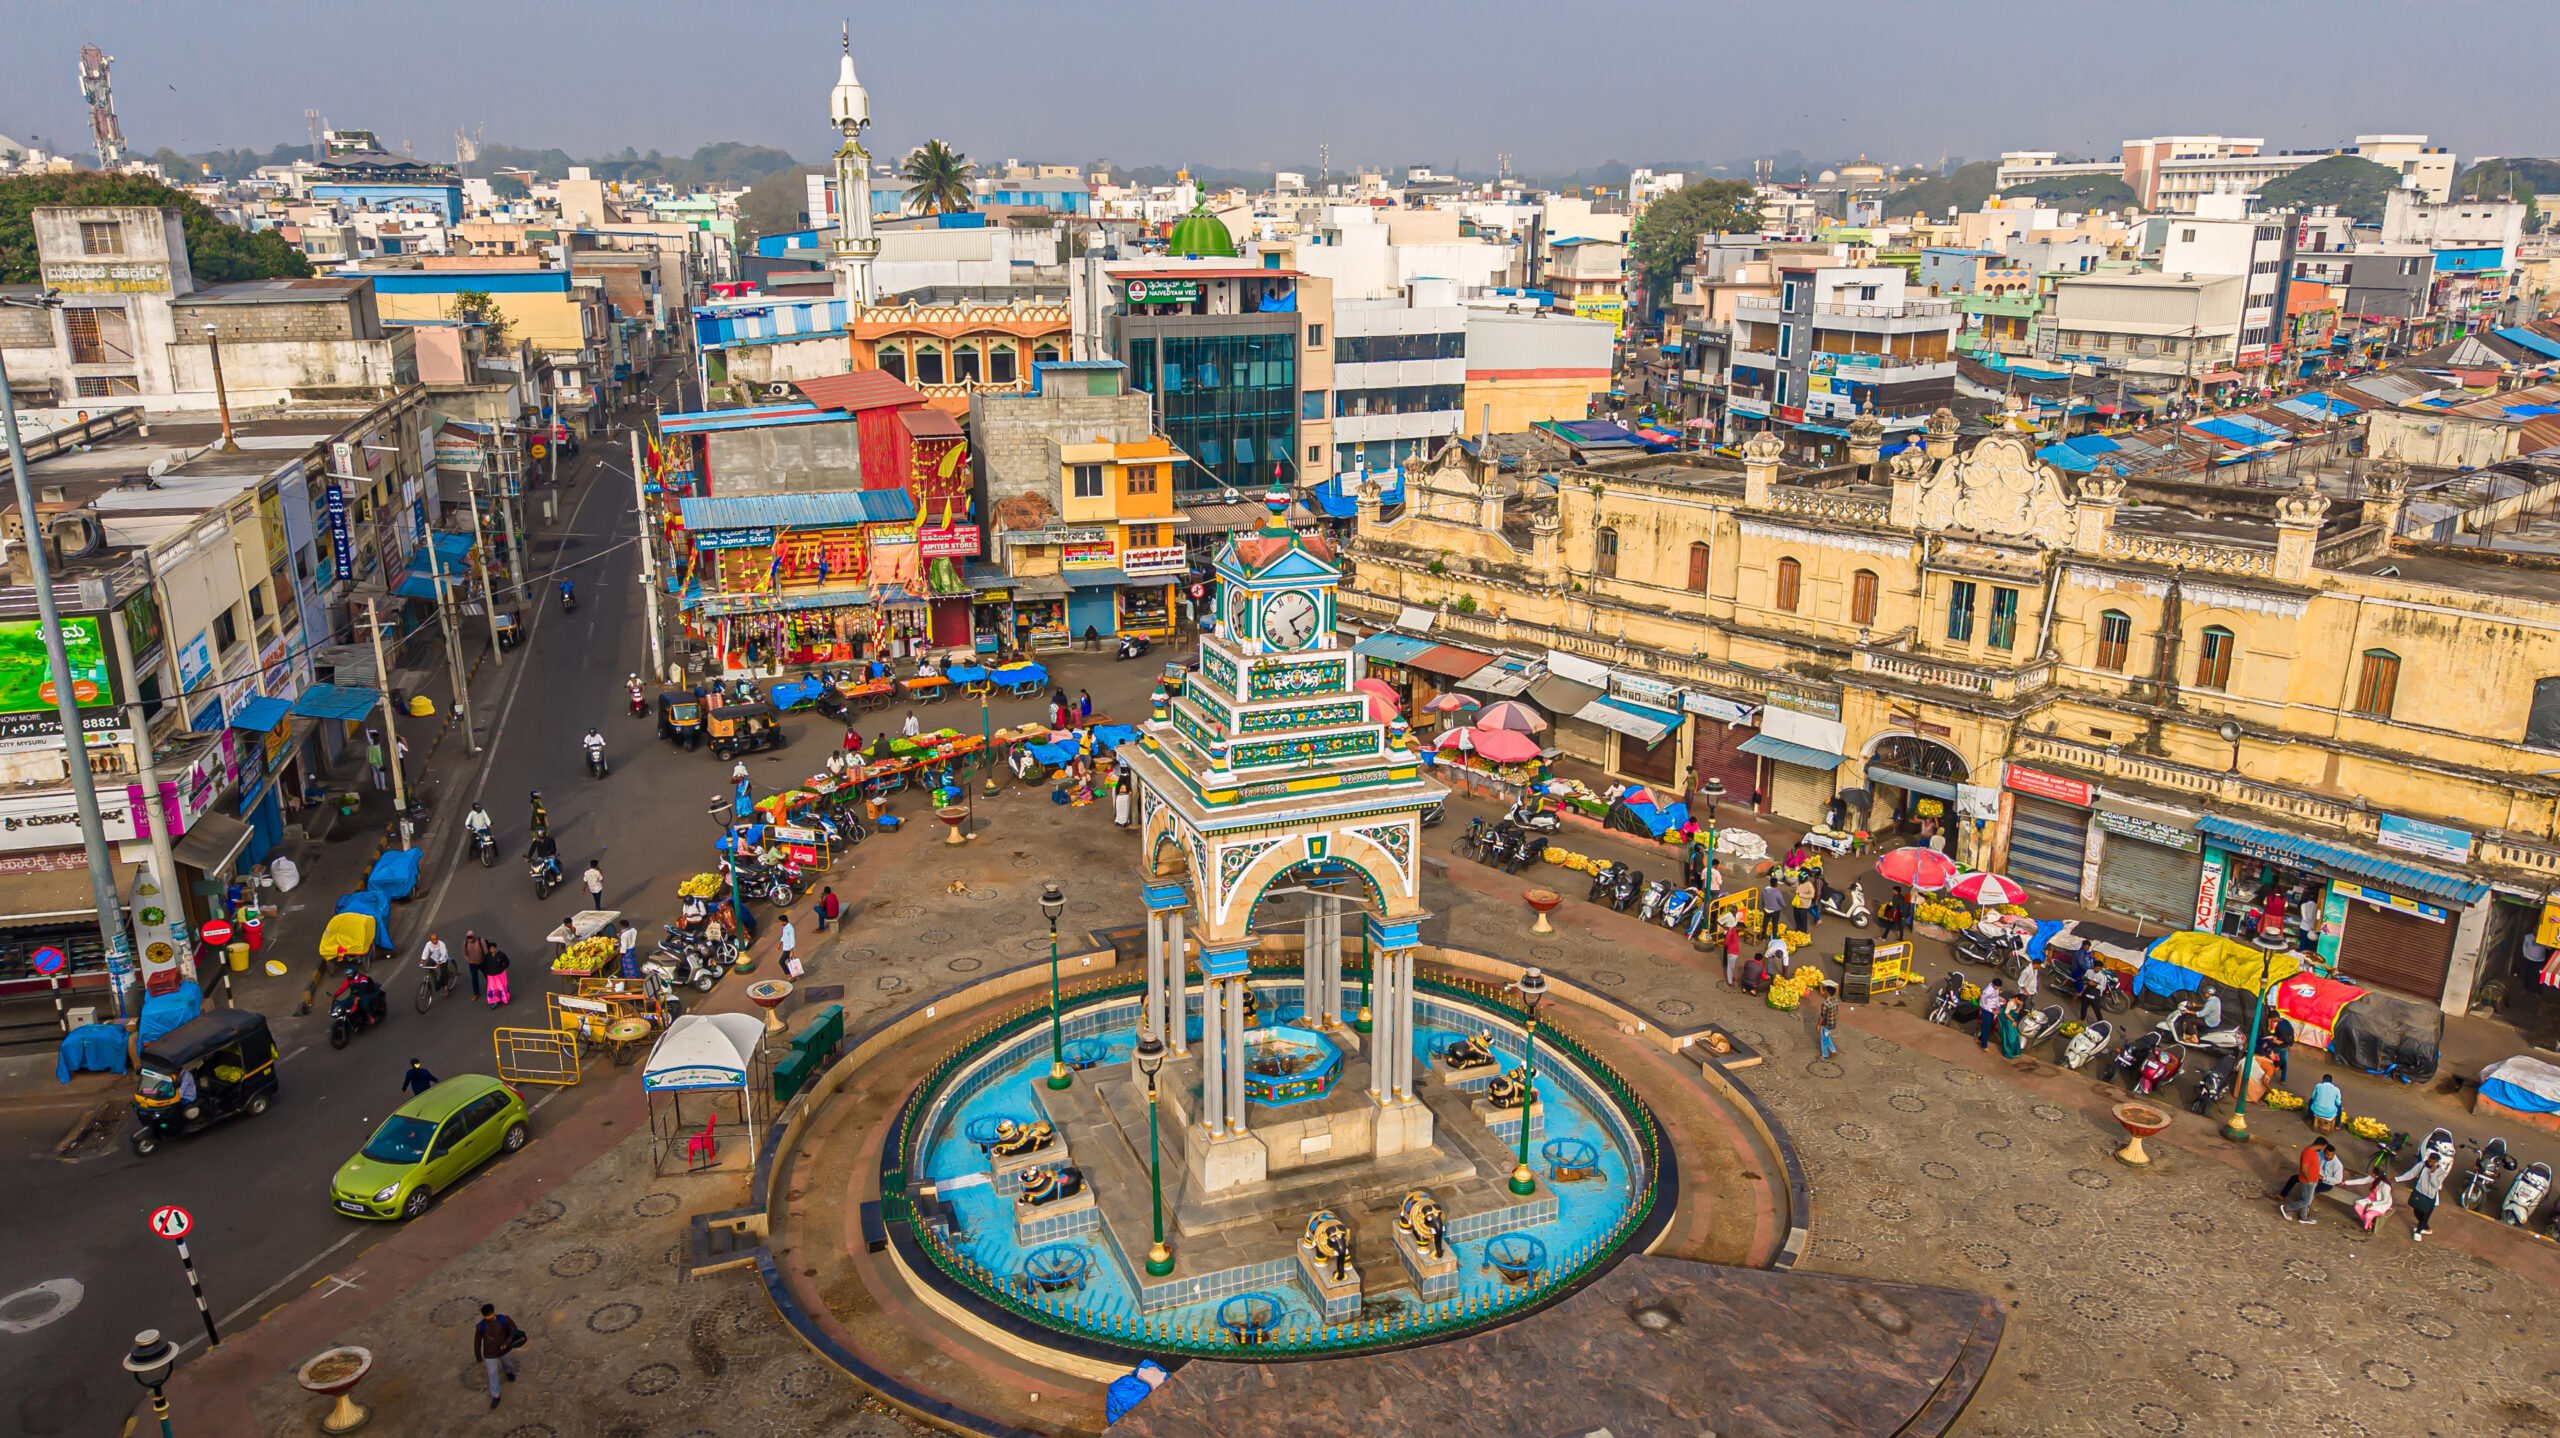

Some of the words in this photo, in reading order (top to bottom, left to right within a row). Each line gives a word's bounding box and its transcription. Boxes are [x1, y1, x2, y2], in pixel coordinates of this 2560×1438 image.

[700, 539, 718, 547] New
[720, 537, 747, 545] Jupiter
[11, 723, 34, 734] +91
[82, 717, 121, 729] 88821
[16, 739, 47, 747] MYSURU
[2407, 822, 2444, 835] apsara
[2196, 874, 2217, 929] XEROX
